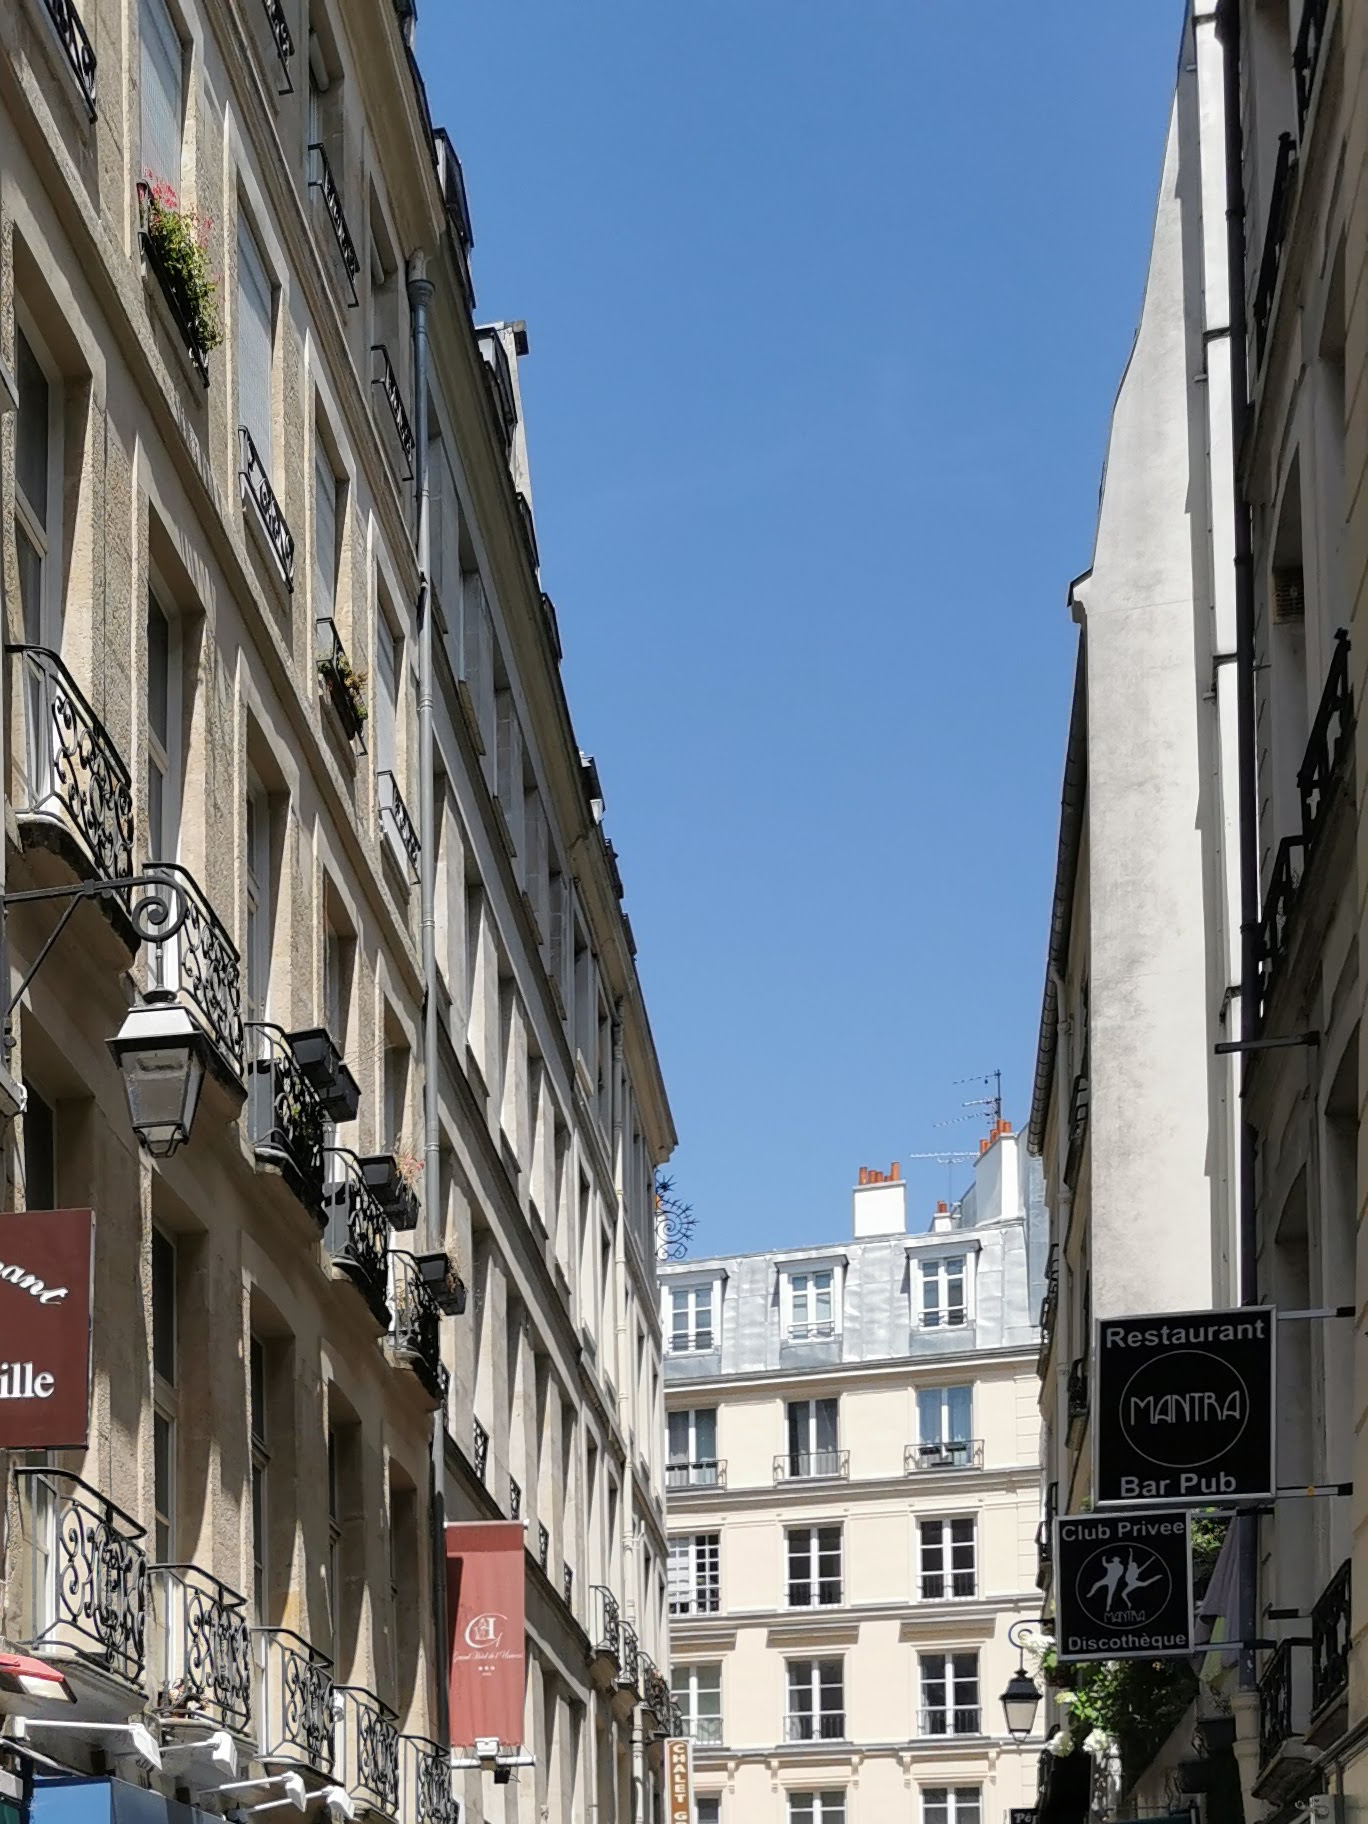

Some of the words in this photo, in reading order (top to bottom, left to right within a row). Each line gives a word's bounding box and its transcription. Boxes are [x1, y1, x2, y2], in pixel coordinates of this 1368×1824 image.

[1106, 1319, 1265, 1348] Restaurant
[1130, 1390, 1241, 1426] MANTRA
[1120, 1476, 1171, 1498] Bar
[1180, 1471, 1237, 1495] Pub
[1062, 1524, 1111, 1541] Club
[1117, 1521, 1185, 1538] Privee
[1068, 1633, 1187, 1651] Discothèque
[673, 1743, 687, 1804] CHALET
